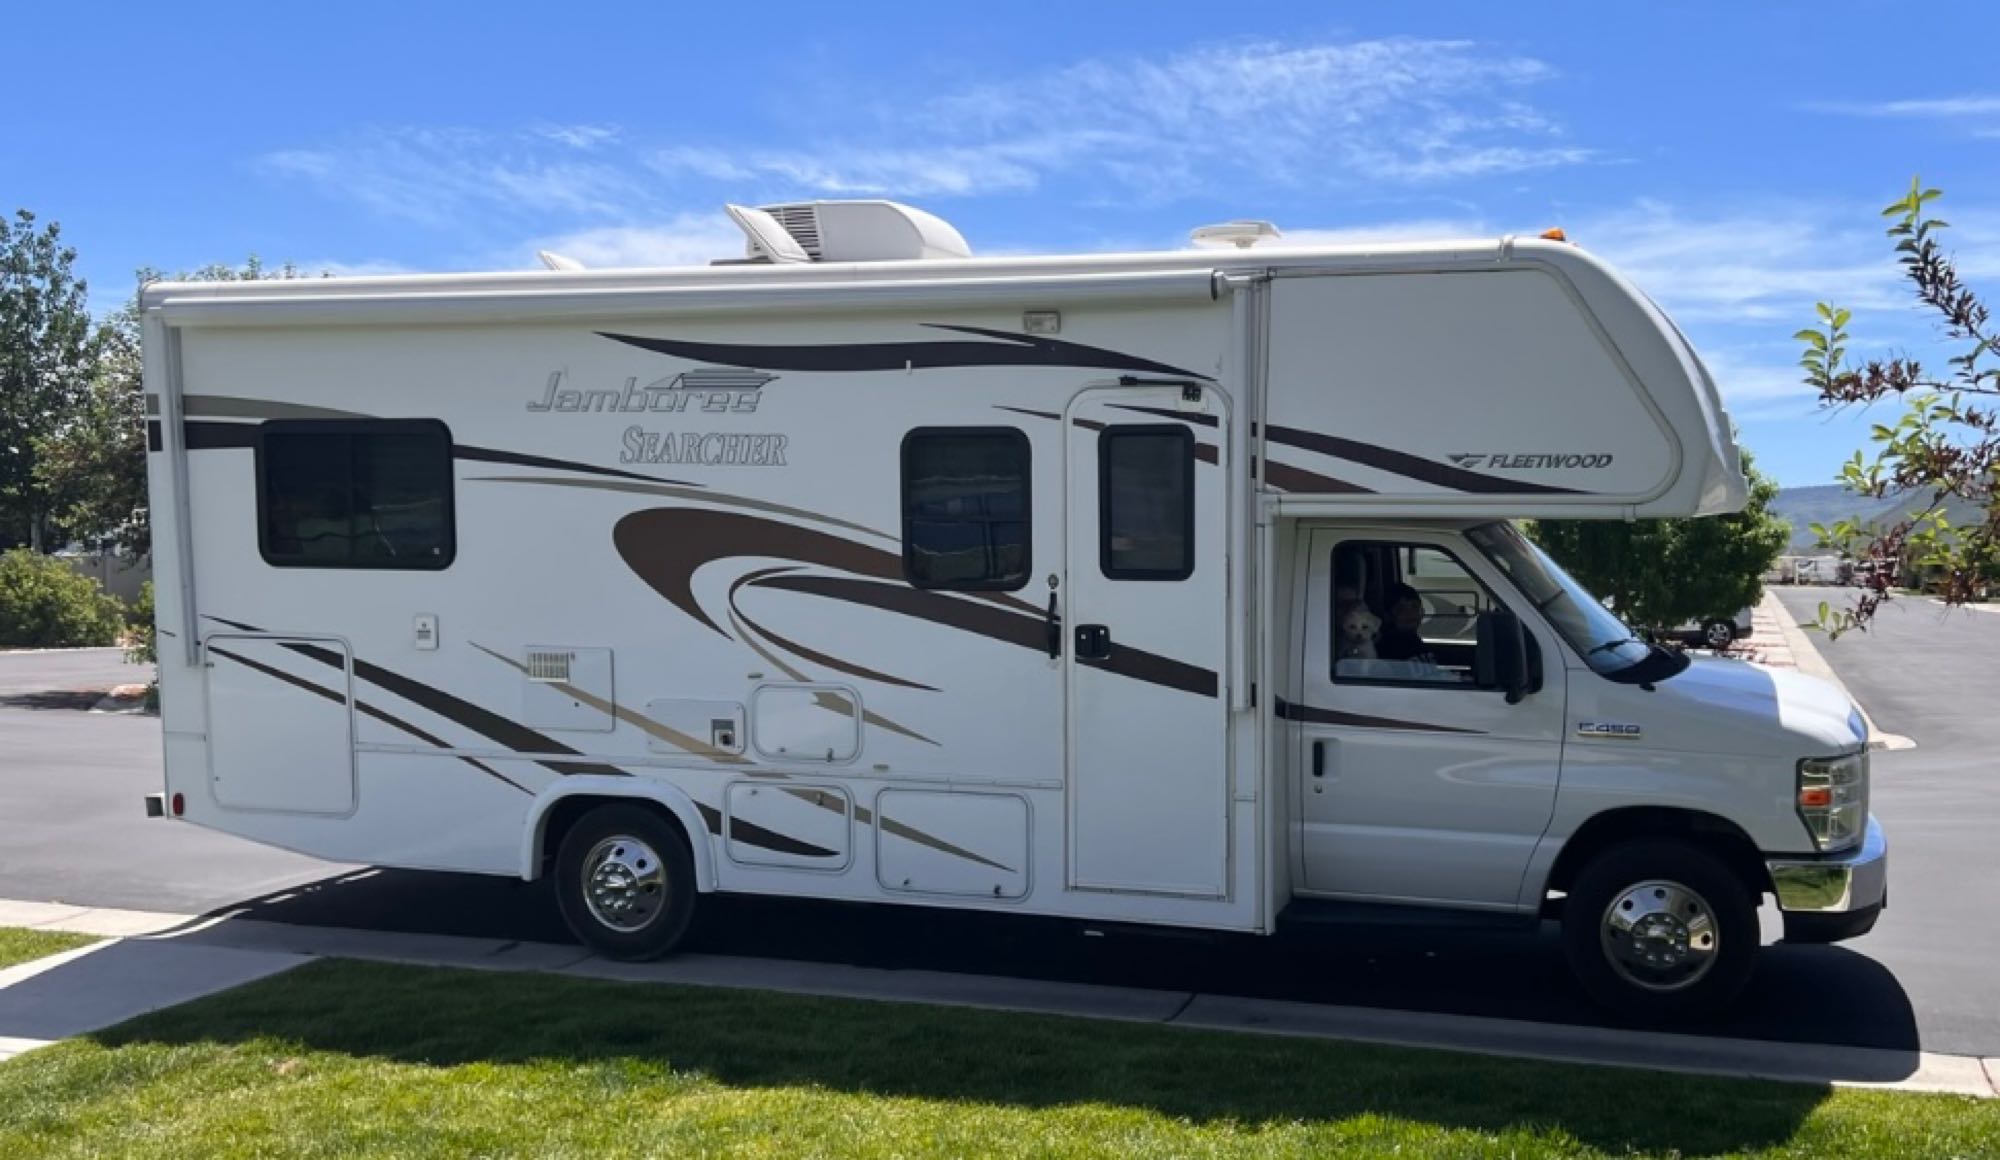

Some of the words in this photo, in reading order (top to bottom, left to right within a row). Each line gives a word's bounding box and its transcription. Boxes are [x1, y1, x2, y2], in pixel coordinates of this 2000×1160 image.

[526, 370, 763, 413] Jamboree
[620, 425, 788, 466] SEARCHER
[1488, 454, 1613, 469] FLEETWOOD
